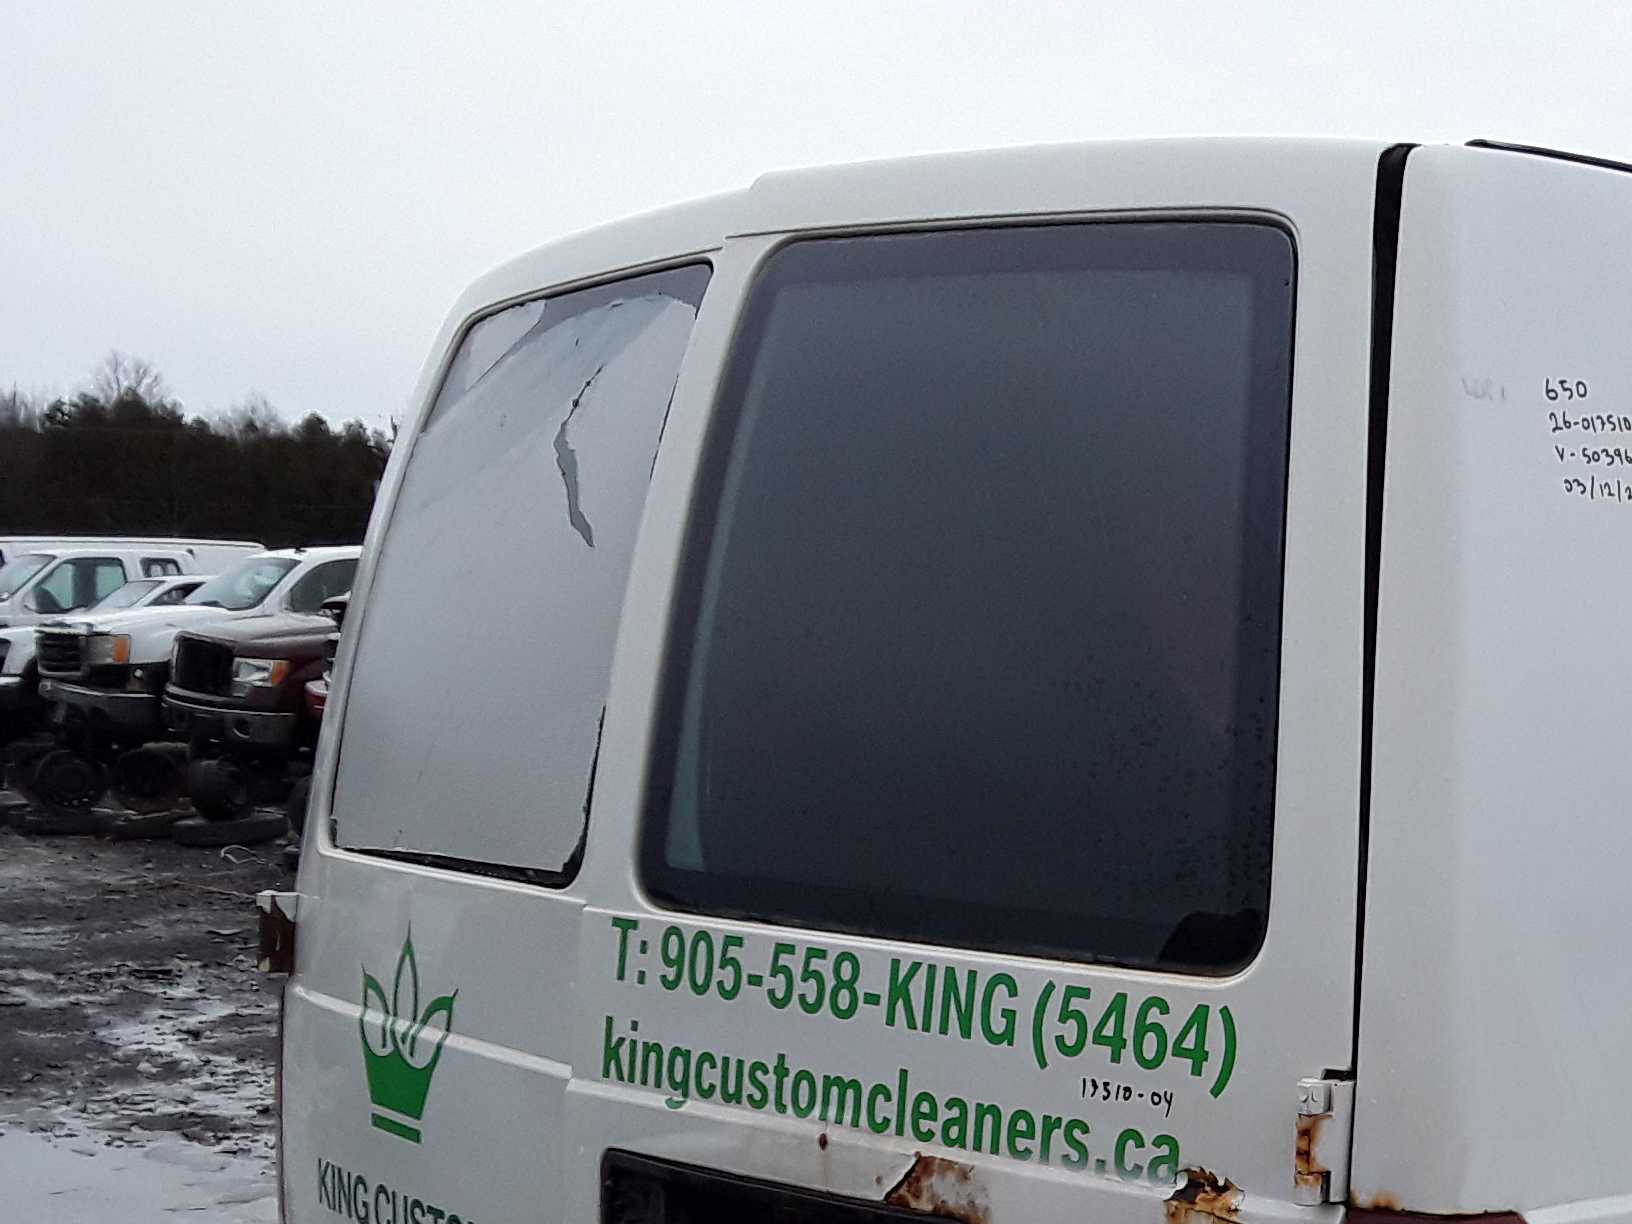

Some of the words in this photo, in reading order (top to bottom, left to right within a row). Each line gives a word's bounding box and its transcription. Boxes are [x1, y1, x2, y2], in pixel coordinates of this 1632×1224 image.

[1545, 377, 1588, 401] 650
[659, 925, 1019, 1048] 905-558-KING
[1032, 978, 1237, 1099] (5464)
[601, 1015, 1180, 1186] kingcustomcleaners.ca
